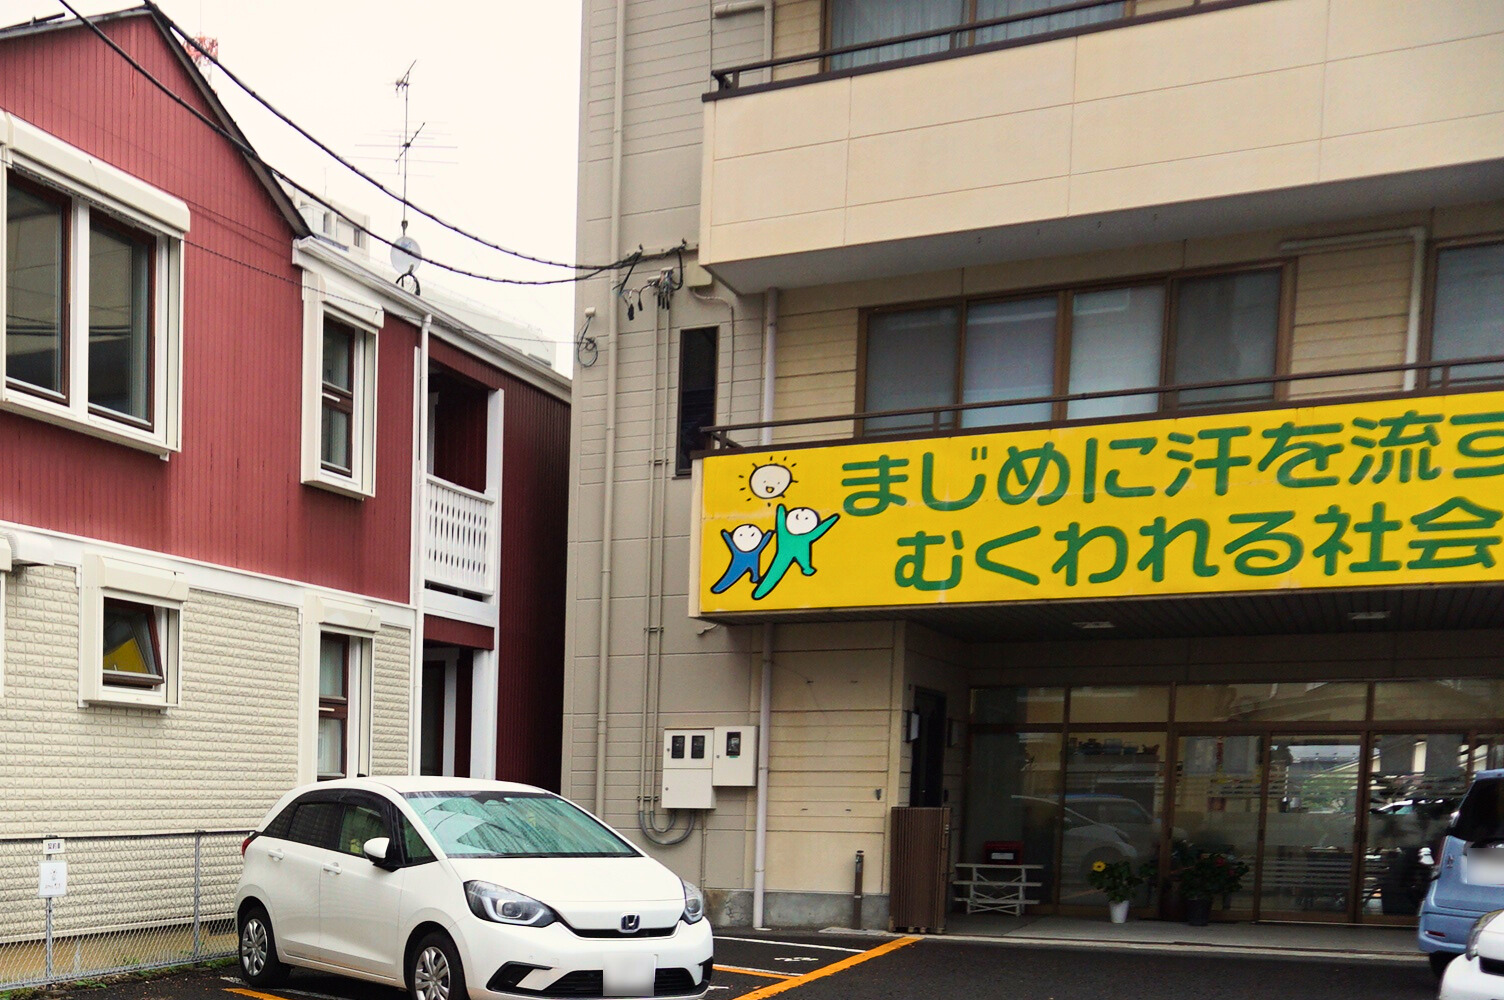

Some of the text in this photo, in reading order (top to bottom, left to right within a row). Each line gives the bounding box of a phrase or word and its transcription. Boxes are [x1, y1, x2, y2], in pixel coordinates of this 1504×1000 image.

[841, 409, 1504, 517] まじめに汗を流す
[894, 496, 1503, 591] むくわれる社会
